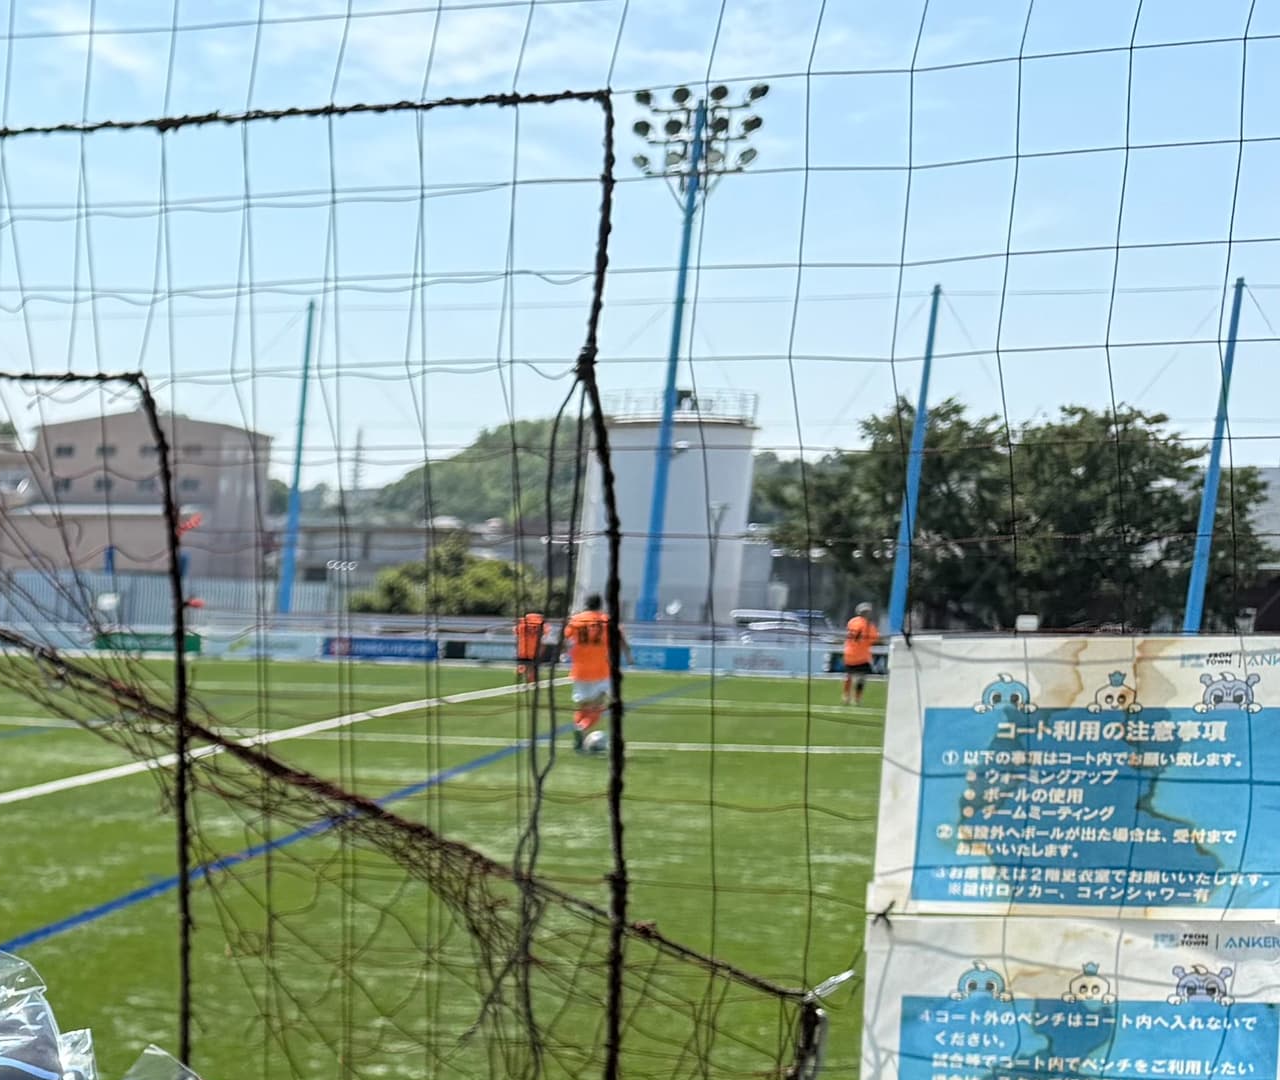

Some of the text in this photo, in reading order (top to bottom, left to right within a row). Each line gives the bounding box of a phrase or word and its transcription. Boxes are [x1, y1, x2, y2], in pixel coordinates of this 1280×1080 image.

[996, 720, 1228, 742] コート利用の注意事項
[986, 769, 1119, 785] ウォーミングアップ
[983, 787, 1083, 804] ボールの使用
[982, 805, 1115, 821] チームミーティング
[935, 1030, 1005, 1048] ください。
